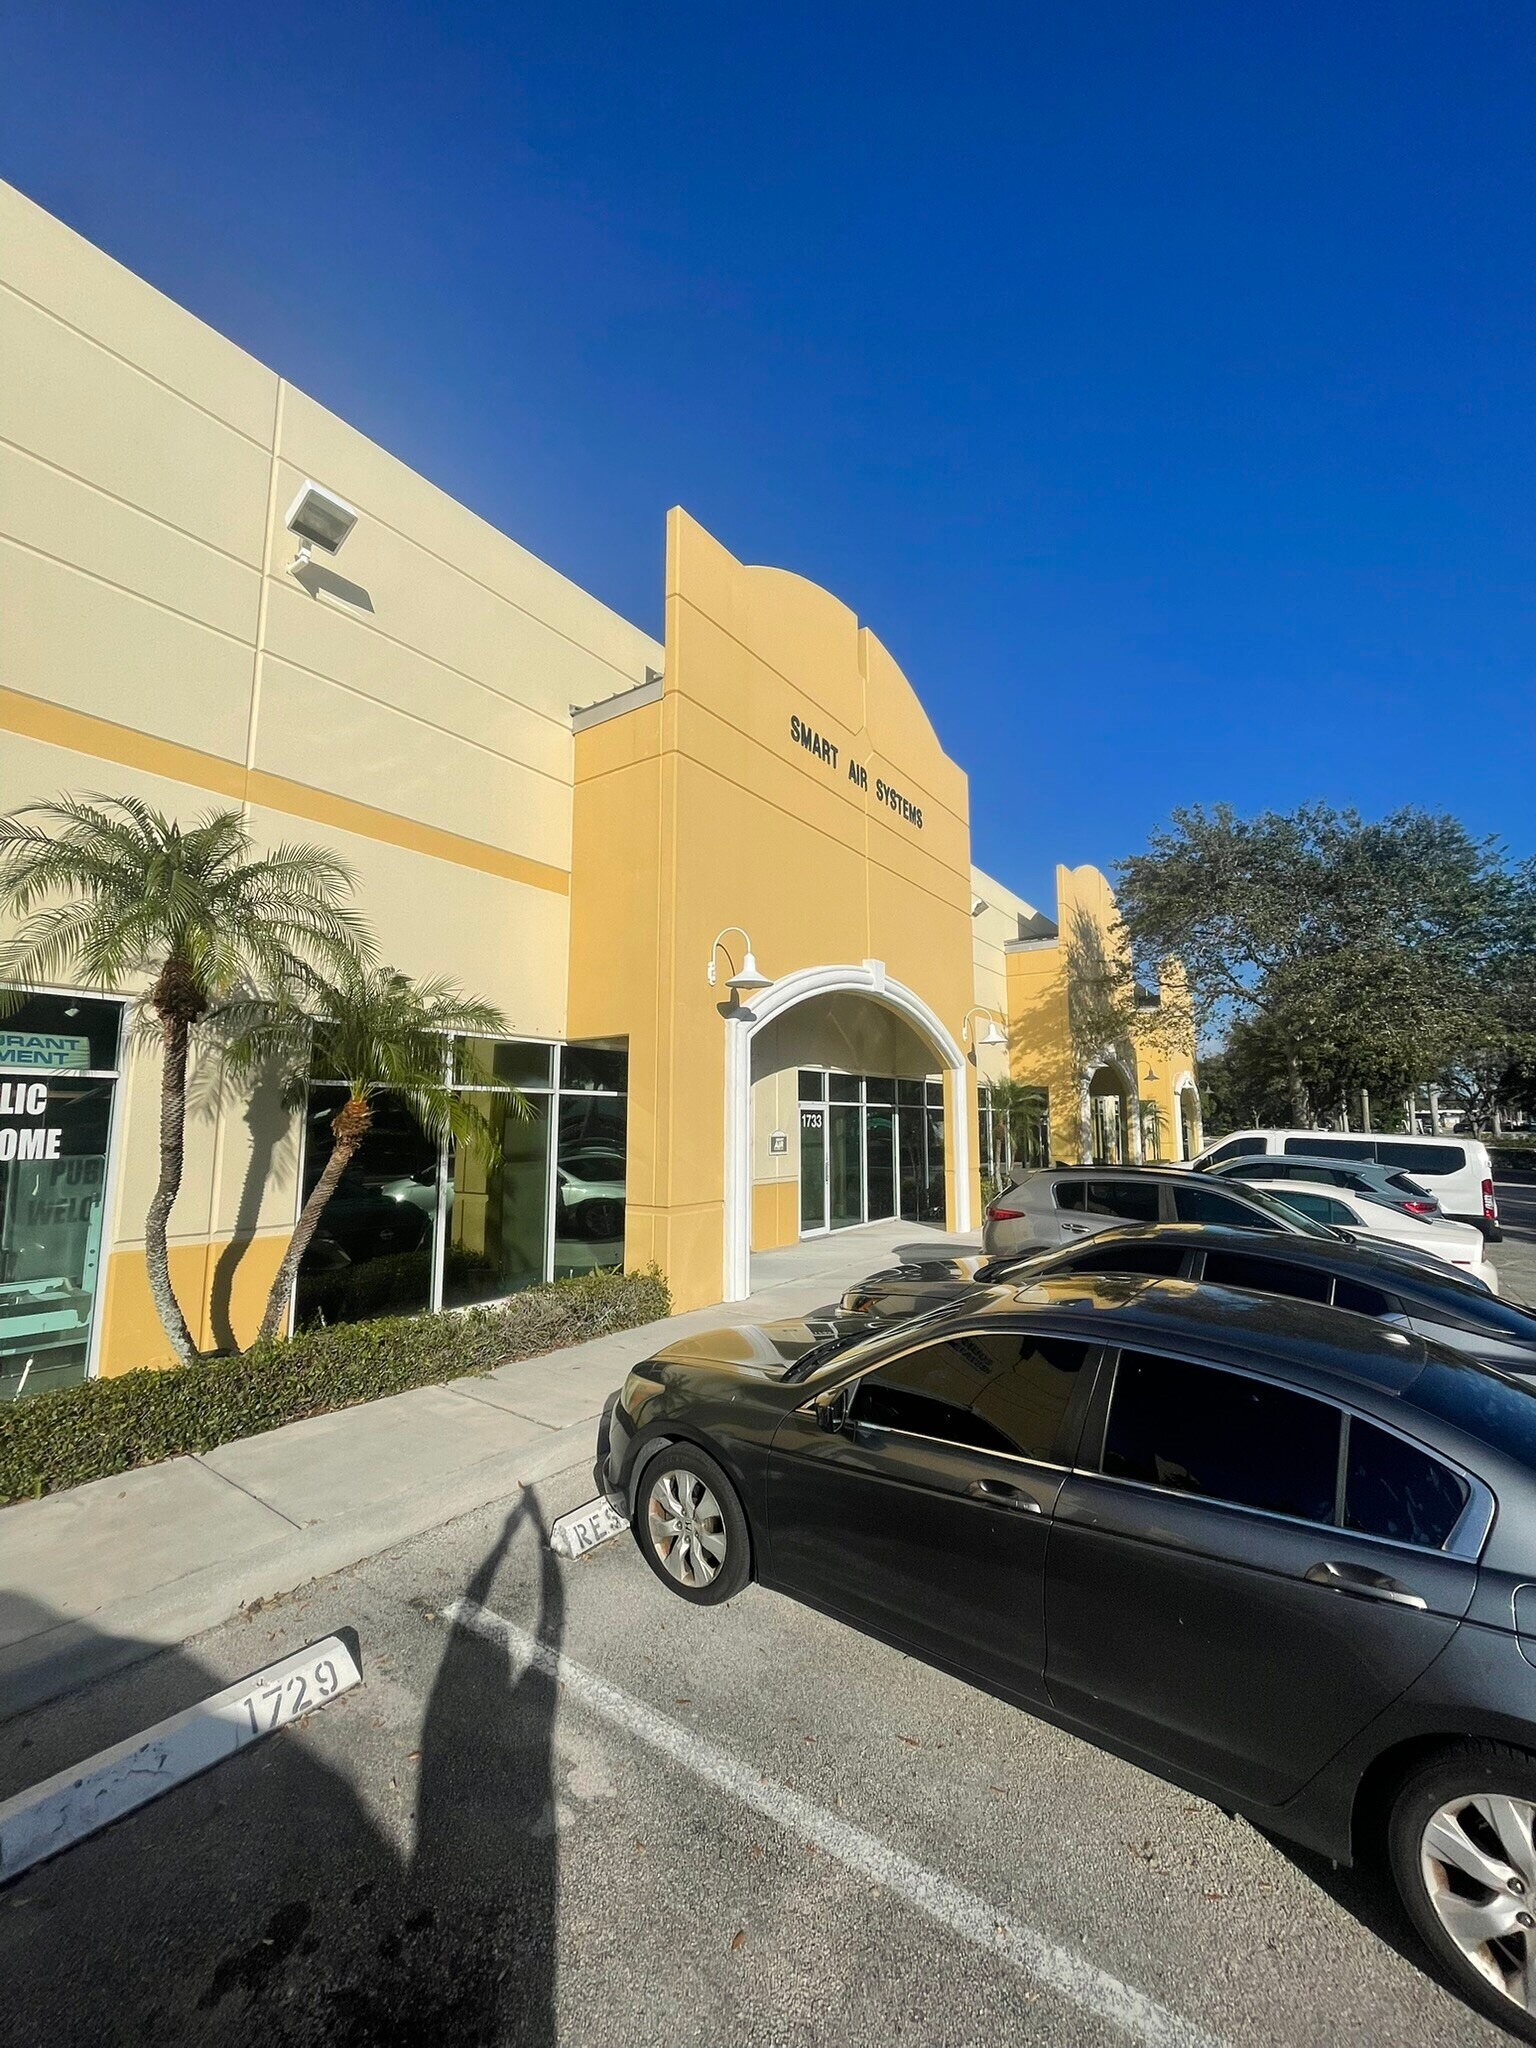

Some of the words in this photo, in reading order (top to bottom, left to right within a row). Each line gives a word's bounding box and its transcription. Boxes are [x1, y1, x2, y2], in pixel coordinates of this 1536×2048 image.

[790, 715, 838, 769] SMART
[848, 759, 868, 792] AIR
[876, 778, 923, 829] SYSTEMS
[0, 1128, 62, 1161] OME
[801, 1114, 822, 1128] 1733
[244, 1661, 338, 1734] 1729
